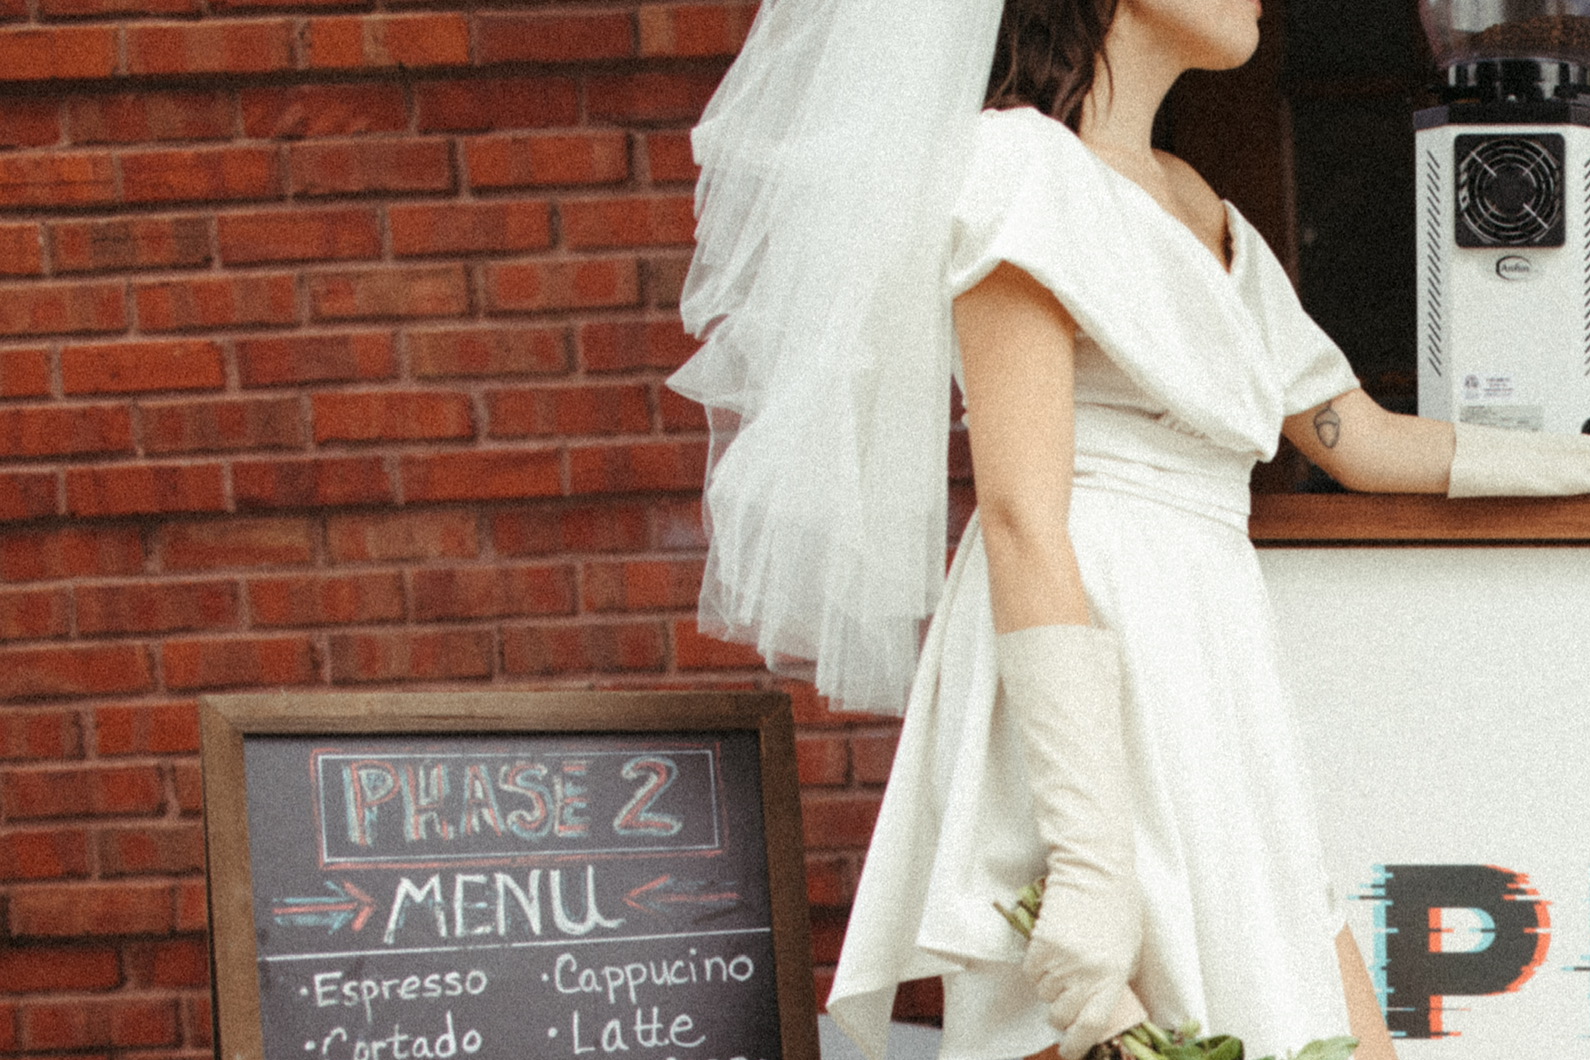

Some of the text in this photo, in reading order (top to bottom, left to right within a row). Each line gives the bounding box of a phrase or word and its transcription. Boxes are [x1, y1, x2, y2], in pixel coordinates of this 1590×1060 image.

[342, 755, 684, 845] PHASE 2
[383, 865, 625, 944] MENU
[313, 970, 488, 1021] Espresso
[553, 948, 754, 1004] Cappucino
[572, 1006, 706, 1055] Latte
